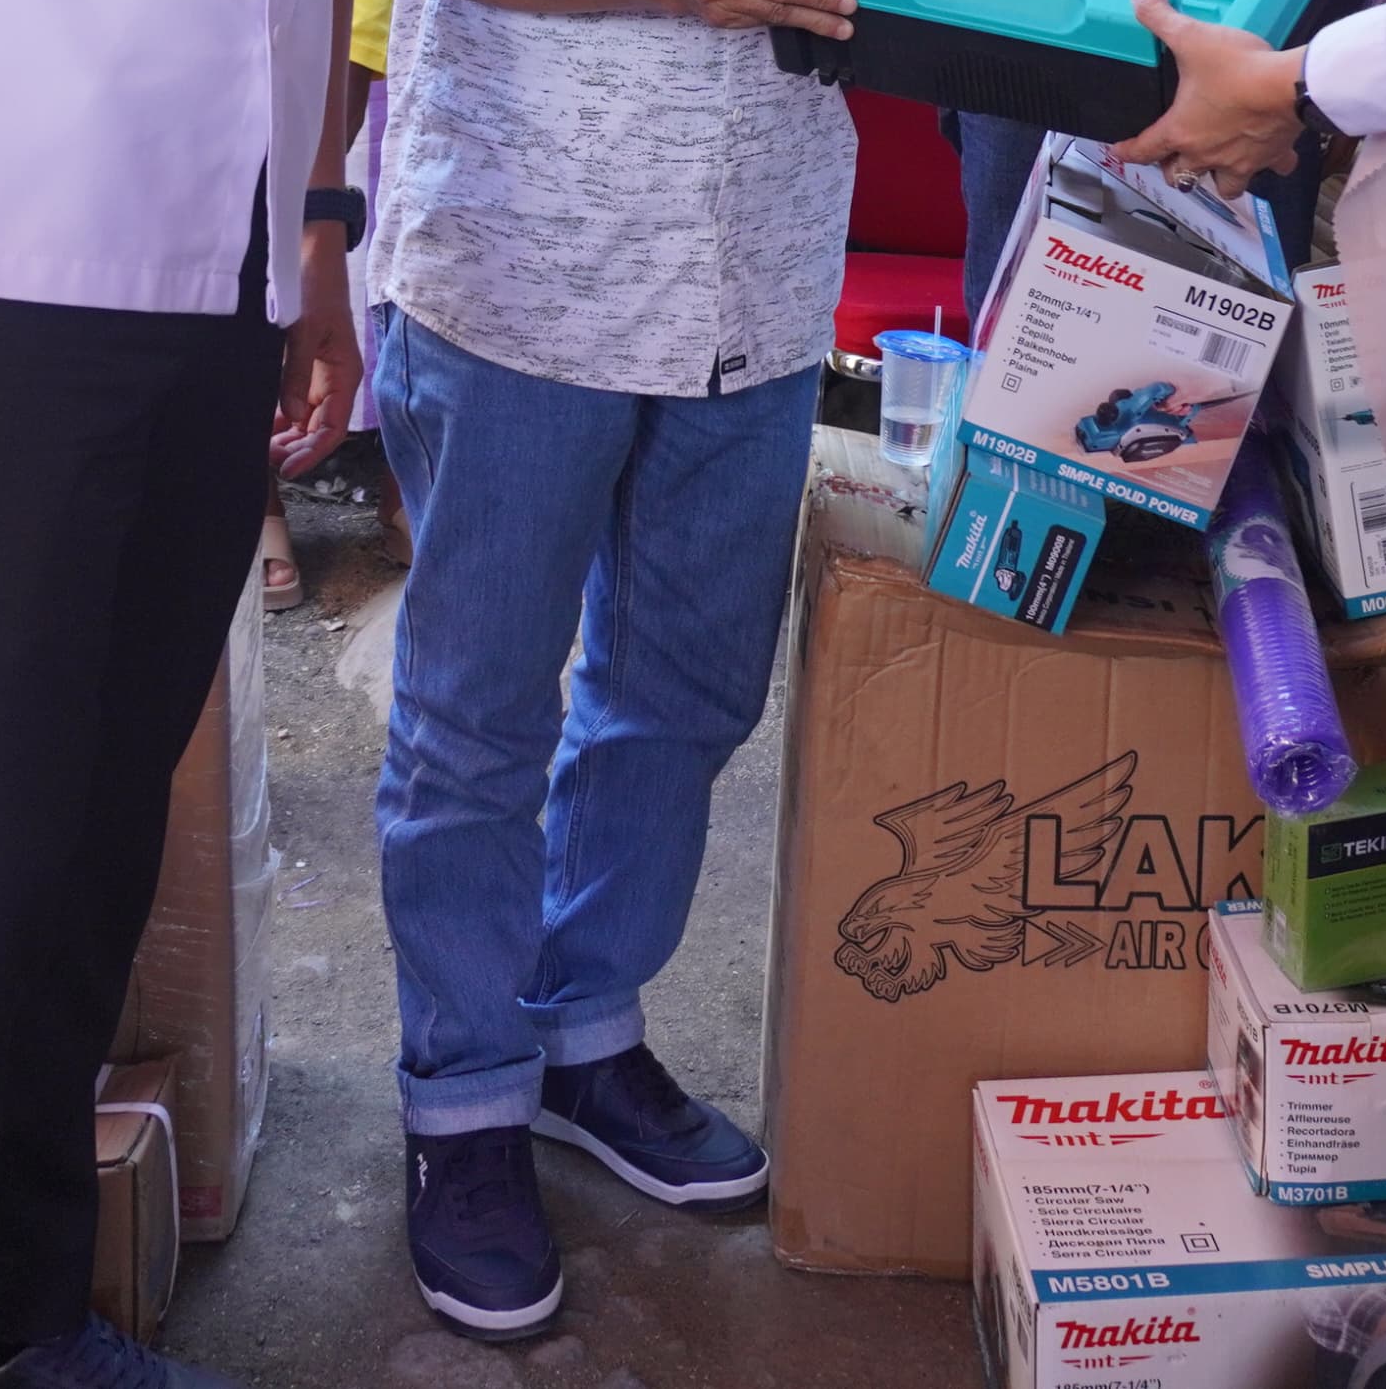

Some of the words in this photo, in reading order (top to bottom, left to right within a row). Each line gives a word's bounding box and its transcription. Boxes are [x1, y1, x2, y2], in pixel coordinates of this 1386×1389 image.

[1029, 302, 1062, 321] Planer
[1184, 286, 1276, 331] M1902B
[1025, 314, 1055, 332] Rabot
[1021, 325, 1056, 345] Cepillo
[1017, 336, 1077, 365] Balkenhobel
[1009, 359, 1039, 377] Plaina
[972, 430, 1038, 465] M1902B
[1057, 463, 1105, 490] SIMPLE
[1106, 482, 1146, 505] SOLID
[1148, 497, 1199, 525] POWER
[1105, 920, 1187, 970] AIR
[1273, 1001, 1369, 1015] M3701B
[1287, 1101, 1334, 1111] Trimmer
[1287, 1114, 1352, 1124] Affleureuse
[1287, 1126, 1356, 1136] Recortadora
[1287, 1138, 1361, 1149] Einhandfräse
[1287, 1152, 1339, 1163] Триммер
[1287, 1164, 1317, 1175] Tupia
[1278, 1186, 1349, 1202] M3701B
[1034, 1196, 1092, 1205] Circular
[1094, 1196, 1125, 1204] Saw
[1037, 1207, 1070, 1215] Scie
[1072, 1206, 1143, 1215] Circulaire
[1041, 1217, 1085, 1226] Sierra
[1087, 1216, 1145, 1225] Circular
[1044, 1226, 1153, 1236] Handkreissäge
[1051, 1249, 1092, 1258] Serra
[1095, 1248, 1153, 1257] Circular
[1047, 1272, 1171, 1294] M5801B
